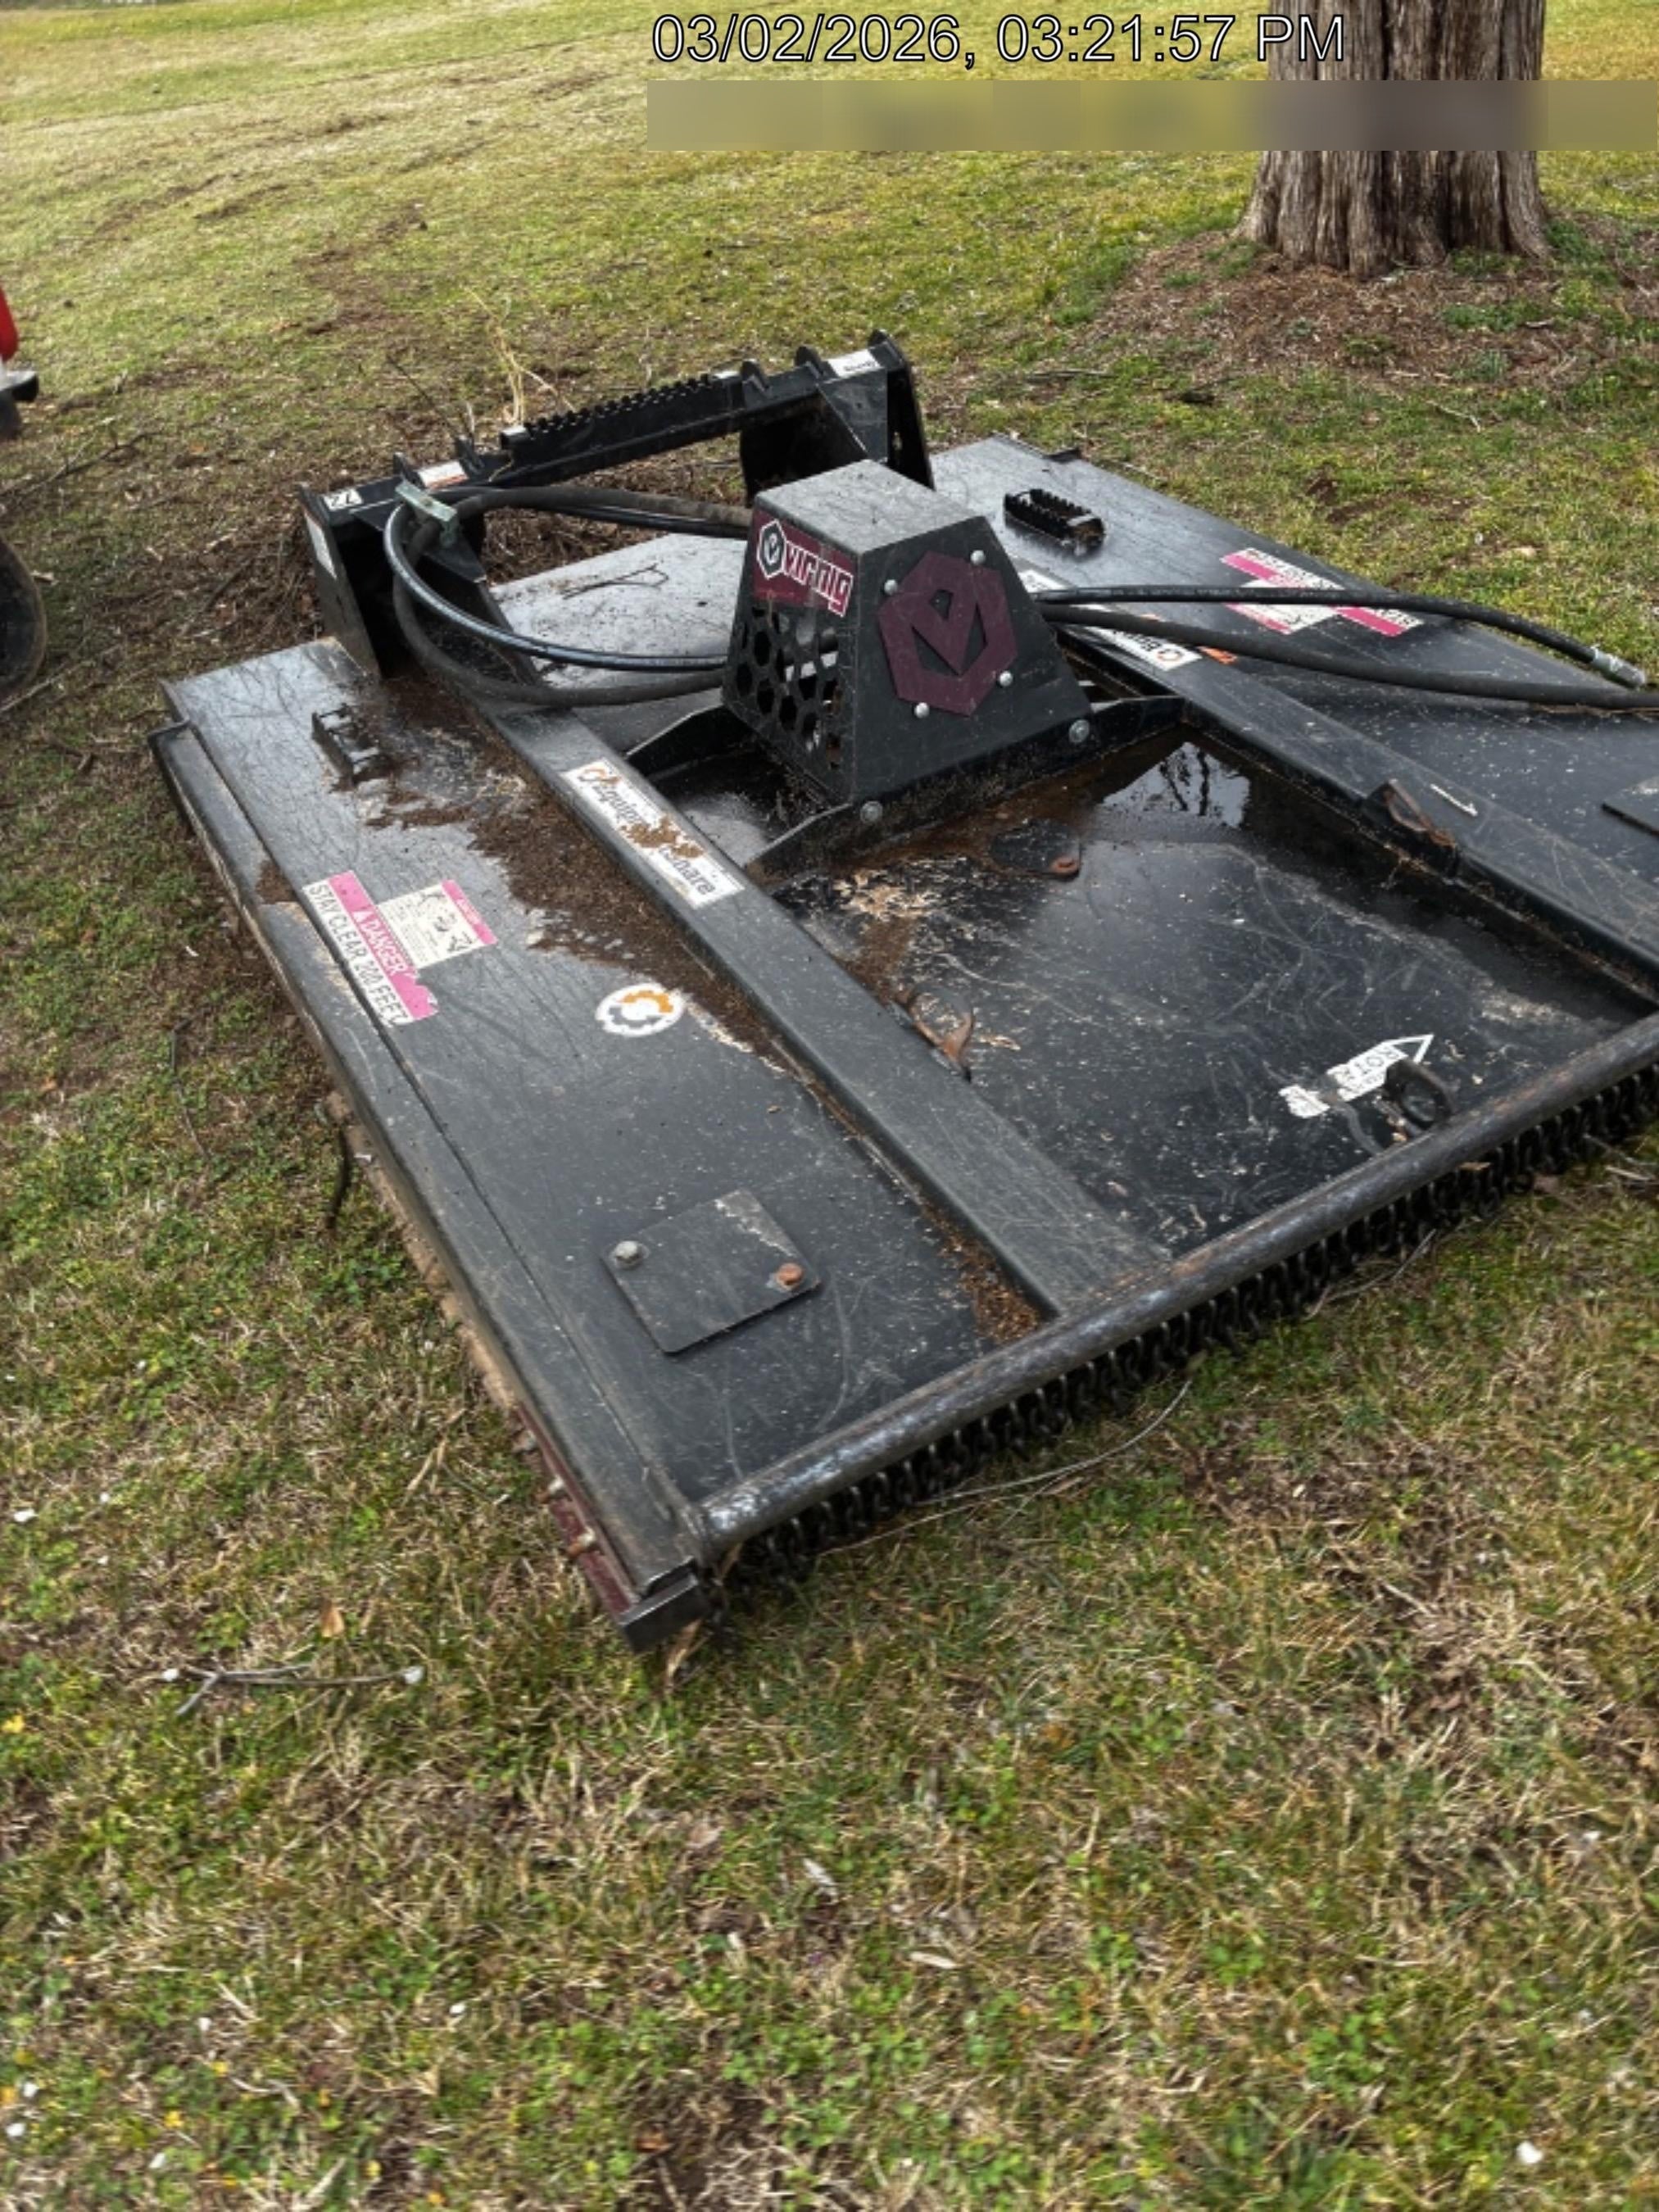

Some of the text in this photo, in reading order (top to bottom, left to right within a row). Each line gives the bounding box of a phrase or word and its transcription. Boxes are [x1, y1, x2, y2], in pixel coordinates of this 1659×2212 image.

[306, 882, 340, 918] STAY
[327, 913, 370, 961] CLEAR
[360, 917, 409, 977] DANGER
